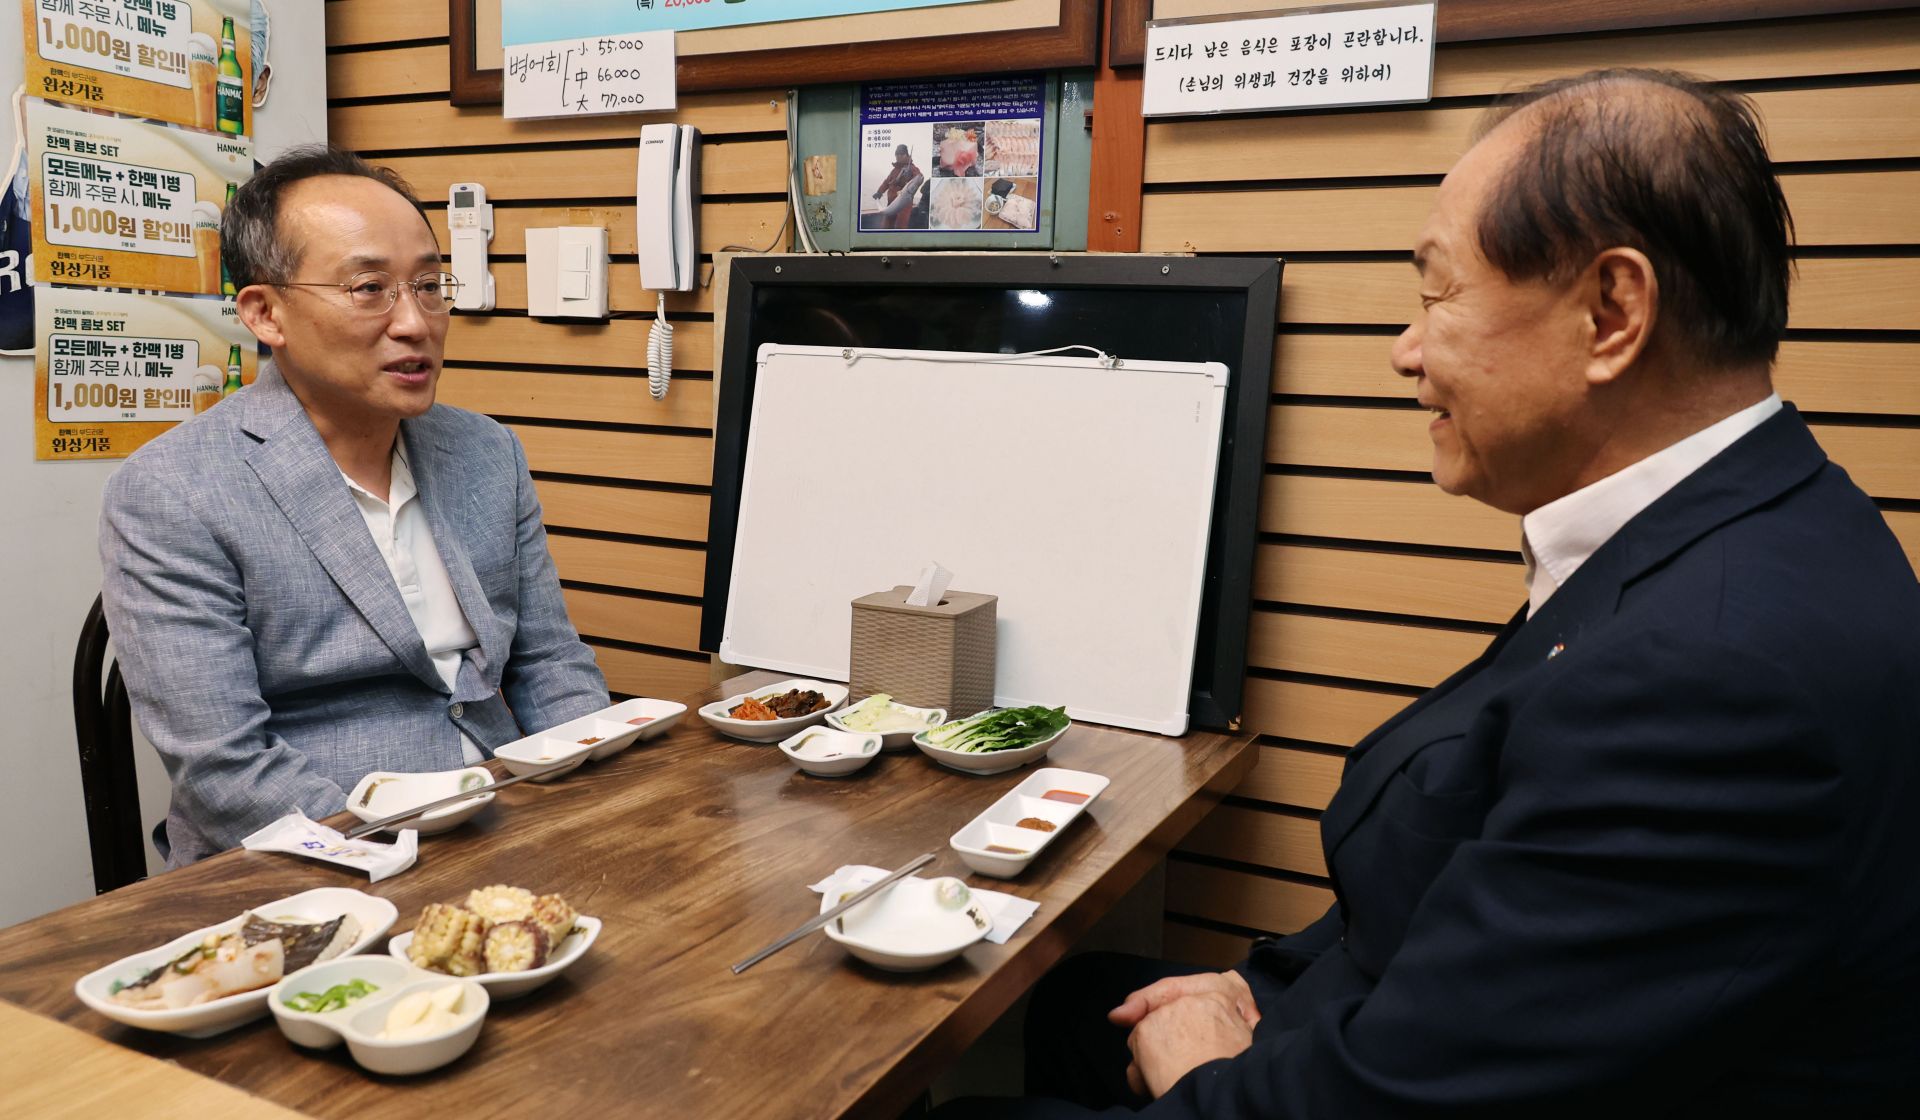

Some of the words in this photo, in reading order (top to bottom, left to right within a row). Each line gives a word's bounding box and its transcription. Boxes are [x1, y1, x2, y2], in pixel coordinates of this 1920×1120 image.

[79, 2, 110, 24] 주문
[115, 10, 134, 30] 시,
[137, 16, 166, 38] 메뉴
[156, 0, 176, 20] 1병
[43, 18, 131, 62] 1,000원
[137, 44, 186, 74] 할인!!
[578, 42, 588, 56] 小
[1154, 43, 1193, 62] 드시다
[1204, 41, 1230, 60] 남은
[1240, 36, 1279, 56] 음식은
[1290, 32, 1332, 52] 포장이
[1343, 26, 1424, 48] 곤란합니다.
[510, 51, 561, 83] 병어회
[576, 68, 588, 90] 中
[1178, 74, 1224, 94] (손님의
[1234, 69, 1276, 90] 위생과
[1288, 68, 1328, 86] 건강을
[1340, 64, 1392, 82] 위하여)
[217, 86, 242, 100] HANMAC
[576, 94, 588, 112] 大
[46, 134, 70, 152] 한맥
[74, 138, 97, 155] 콤보
[100, 144, 119, 158] SET
[217, 142, 247, 157] HANMAC
[48, 158, 112, 183] 모든메뉴
[128, 168, 158, 190] 한맥
[160, 174, 180, 192] 1병
[49, 179, 81, 200] 함께
[85, 184, 117, 204] 주문
[120, 188, 140, 207] 시,
[142, 191, 172, 211] 메뉴
[50, 203, 136, 238] 1,000원
[142, 222, 190, 244] 할인!!
[222, 307, 239, 316] HAN
[54, 317, 77, 330] 한맥
[81, 318, 104, 331] 콤보
[106, 320, 125, 332] SET
[54, 338, 117, 358] 모든메뉴
[132, 341, 161, 360] 한맥
[165, 343, 184, 360] 1병
[54, 360, 84, 376] 함께
[89, 361, 120, 377] 주문
[123, 362, 141, 378] 시,
[144, 363, 174, 378] 메뉴
[53, 382, 137, 410] 1,000원
[144, 388, 191, 409] 할인!!
[197, 385, 220, 393] HANMAC
